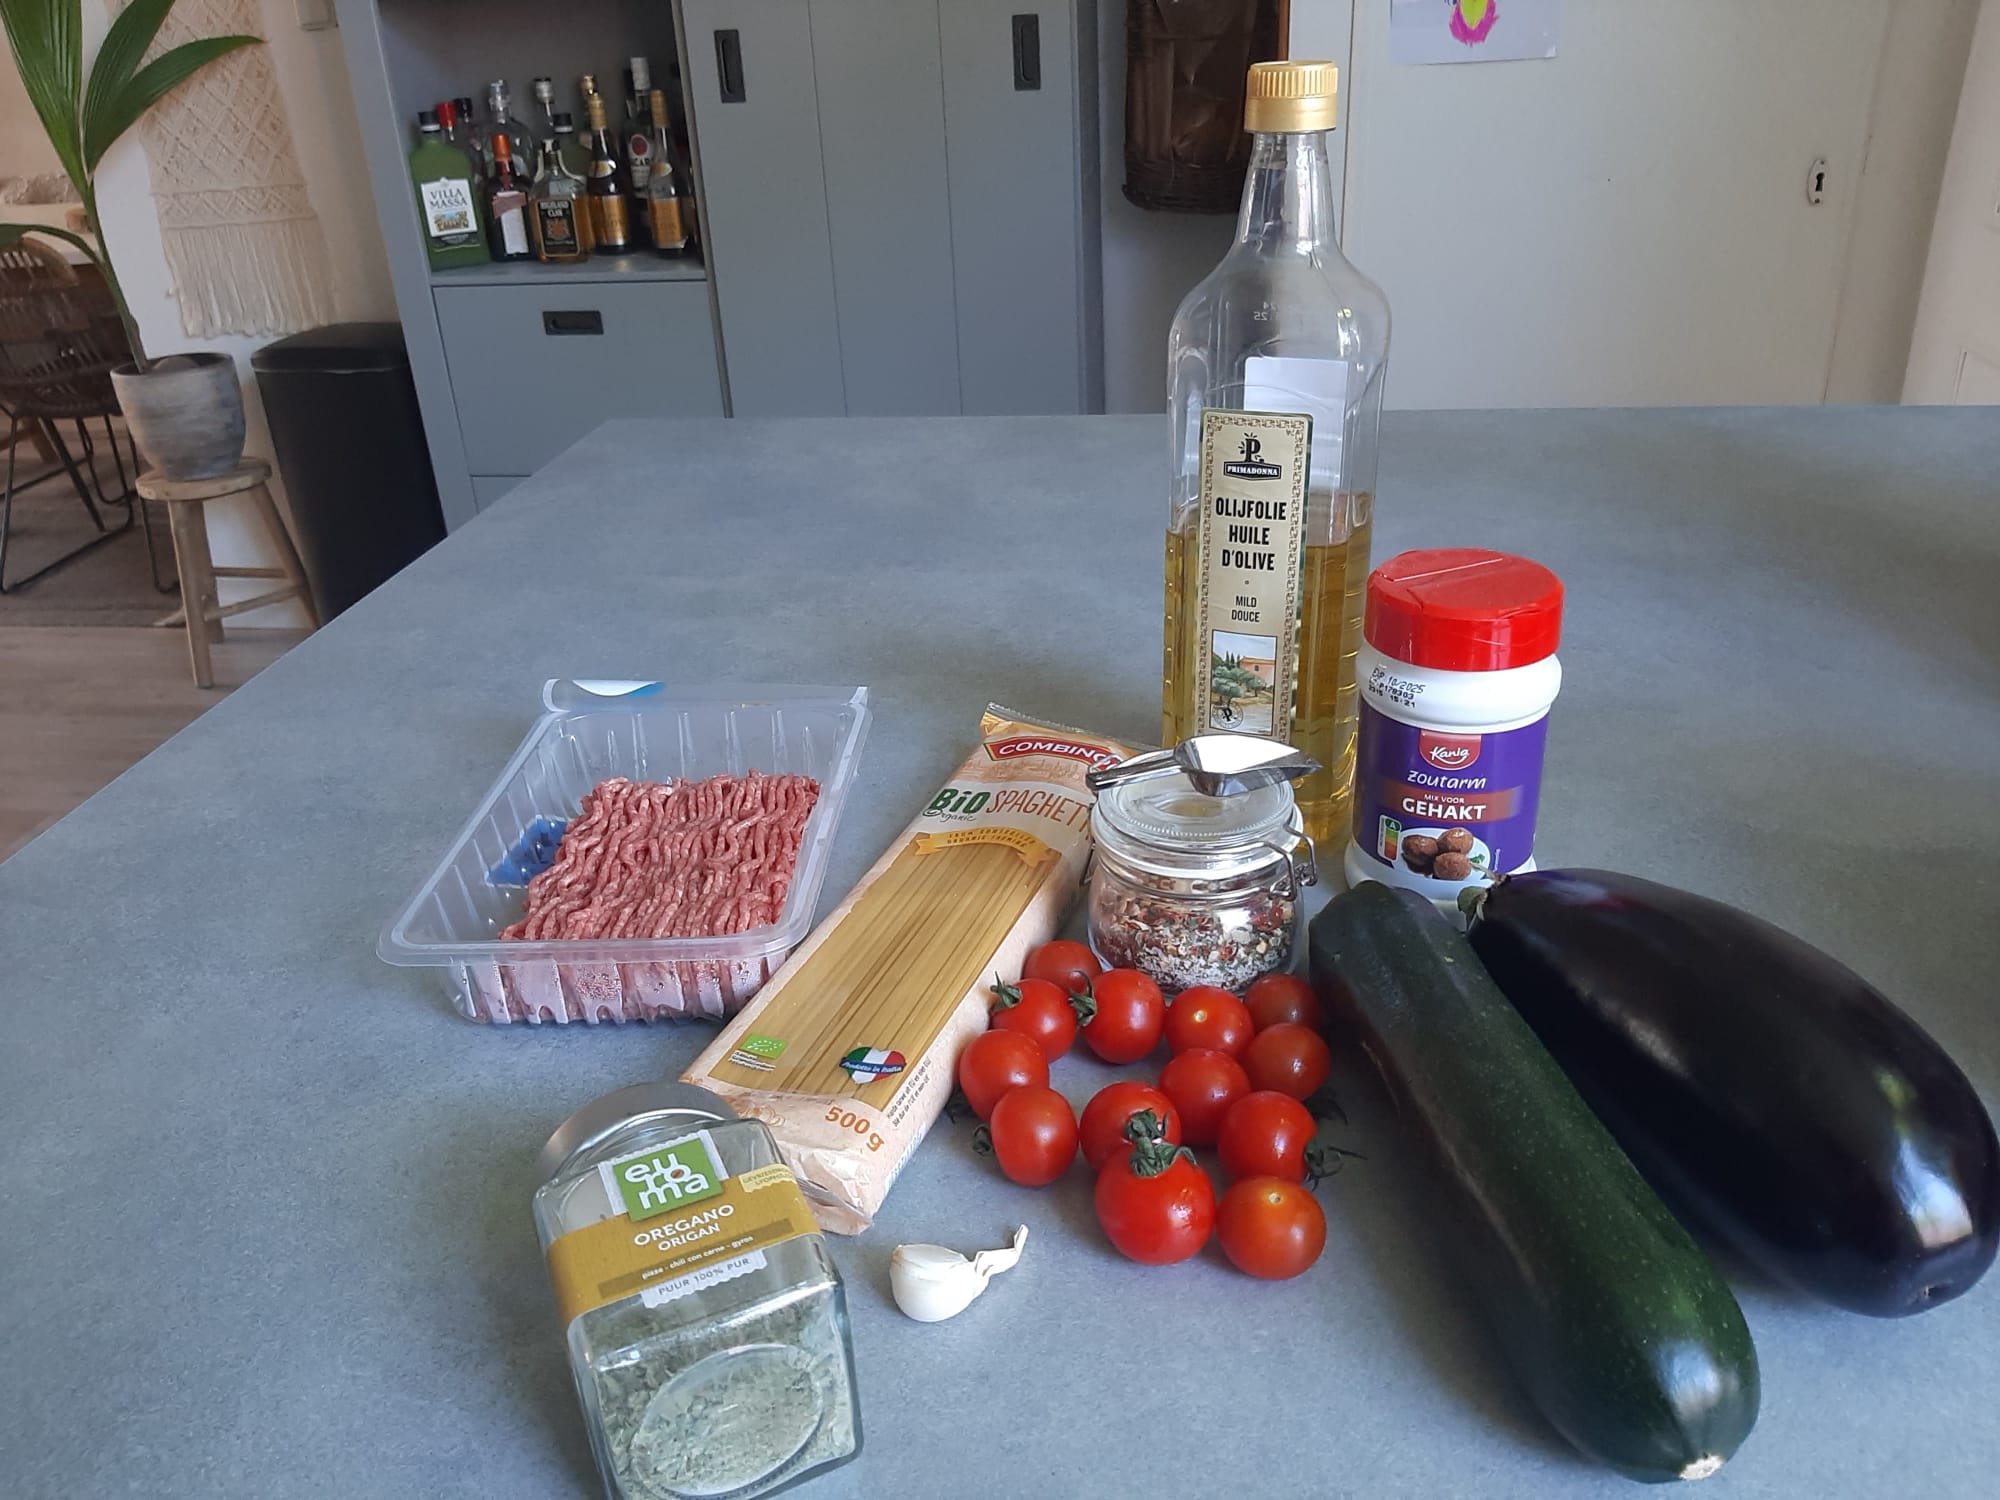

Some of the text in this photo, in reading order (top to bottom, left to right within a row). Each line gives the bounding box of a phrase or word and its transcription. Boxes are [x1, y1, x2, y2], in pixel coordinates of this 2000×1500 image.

[430, 189, 463, 200] VILLA
[430, 197, 468, 209] MASSA
[1227, 465, 1279, 476] PRIMADONNA
[1215, 496, 1288, 522] OLIJFOLIE
[1228, 524, 1271, 546] HUILE
[1221, 549, 1276, 572] D'OLIVE
[1235, 596, 1257, 609] MILD
[1231, 609, 1261, 623] DOUCE
[1429, 746, 1470, 764] Kania
[1407, 770, 1487, 790] zoutarm
[1402, 798, 1487, 820] GEHAKT
[1424, 794, 1465, 804] MIX VOOR
[922, 808, 976, 822] Organic
[633, 1204, 735, 1246] OREGANO
[658, 1223, 720, 1251] ORIGAN
[669, 1258, 686, 1269] chili
[687, 1254, 702, 1263] con
[703, 1245, 725, 1257] carne
[731, 1236, 754, 1248] gyros
[658, 1258, 751, 1296] PUUR 100% PUR
